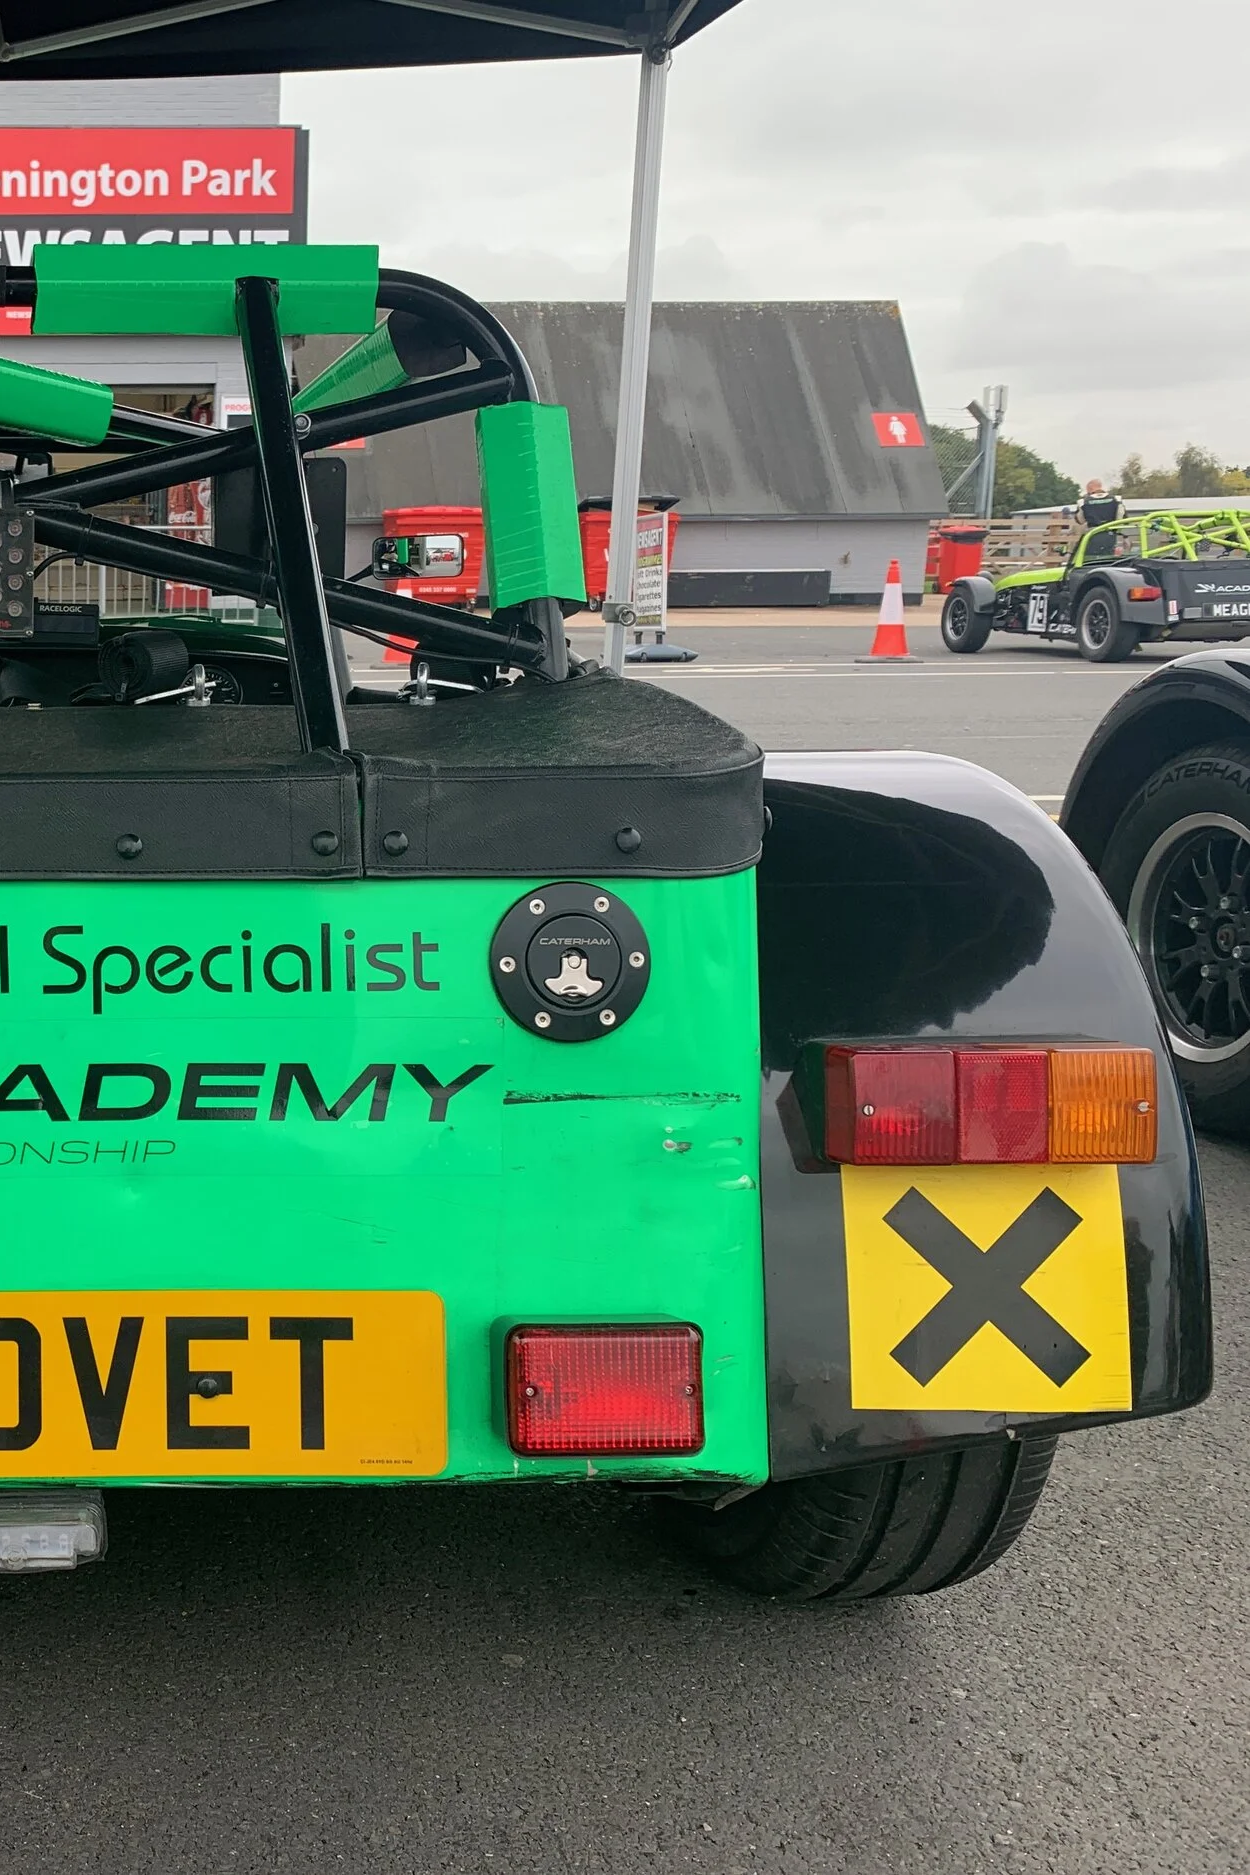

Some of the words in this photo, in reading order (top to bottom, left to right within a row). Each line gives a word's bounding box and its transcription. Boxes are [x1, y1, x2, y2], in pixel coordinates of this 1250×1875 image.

[182, 158, 277, 198] Park
[1031, 595, 1045, 625] 79
[1213, 603, 1250, 617] MEAG
[42, 922, 441, 1015] Specialist
